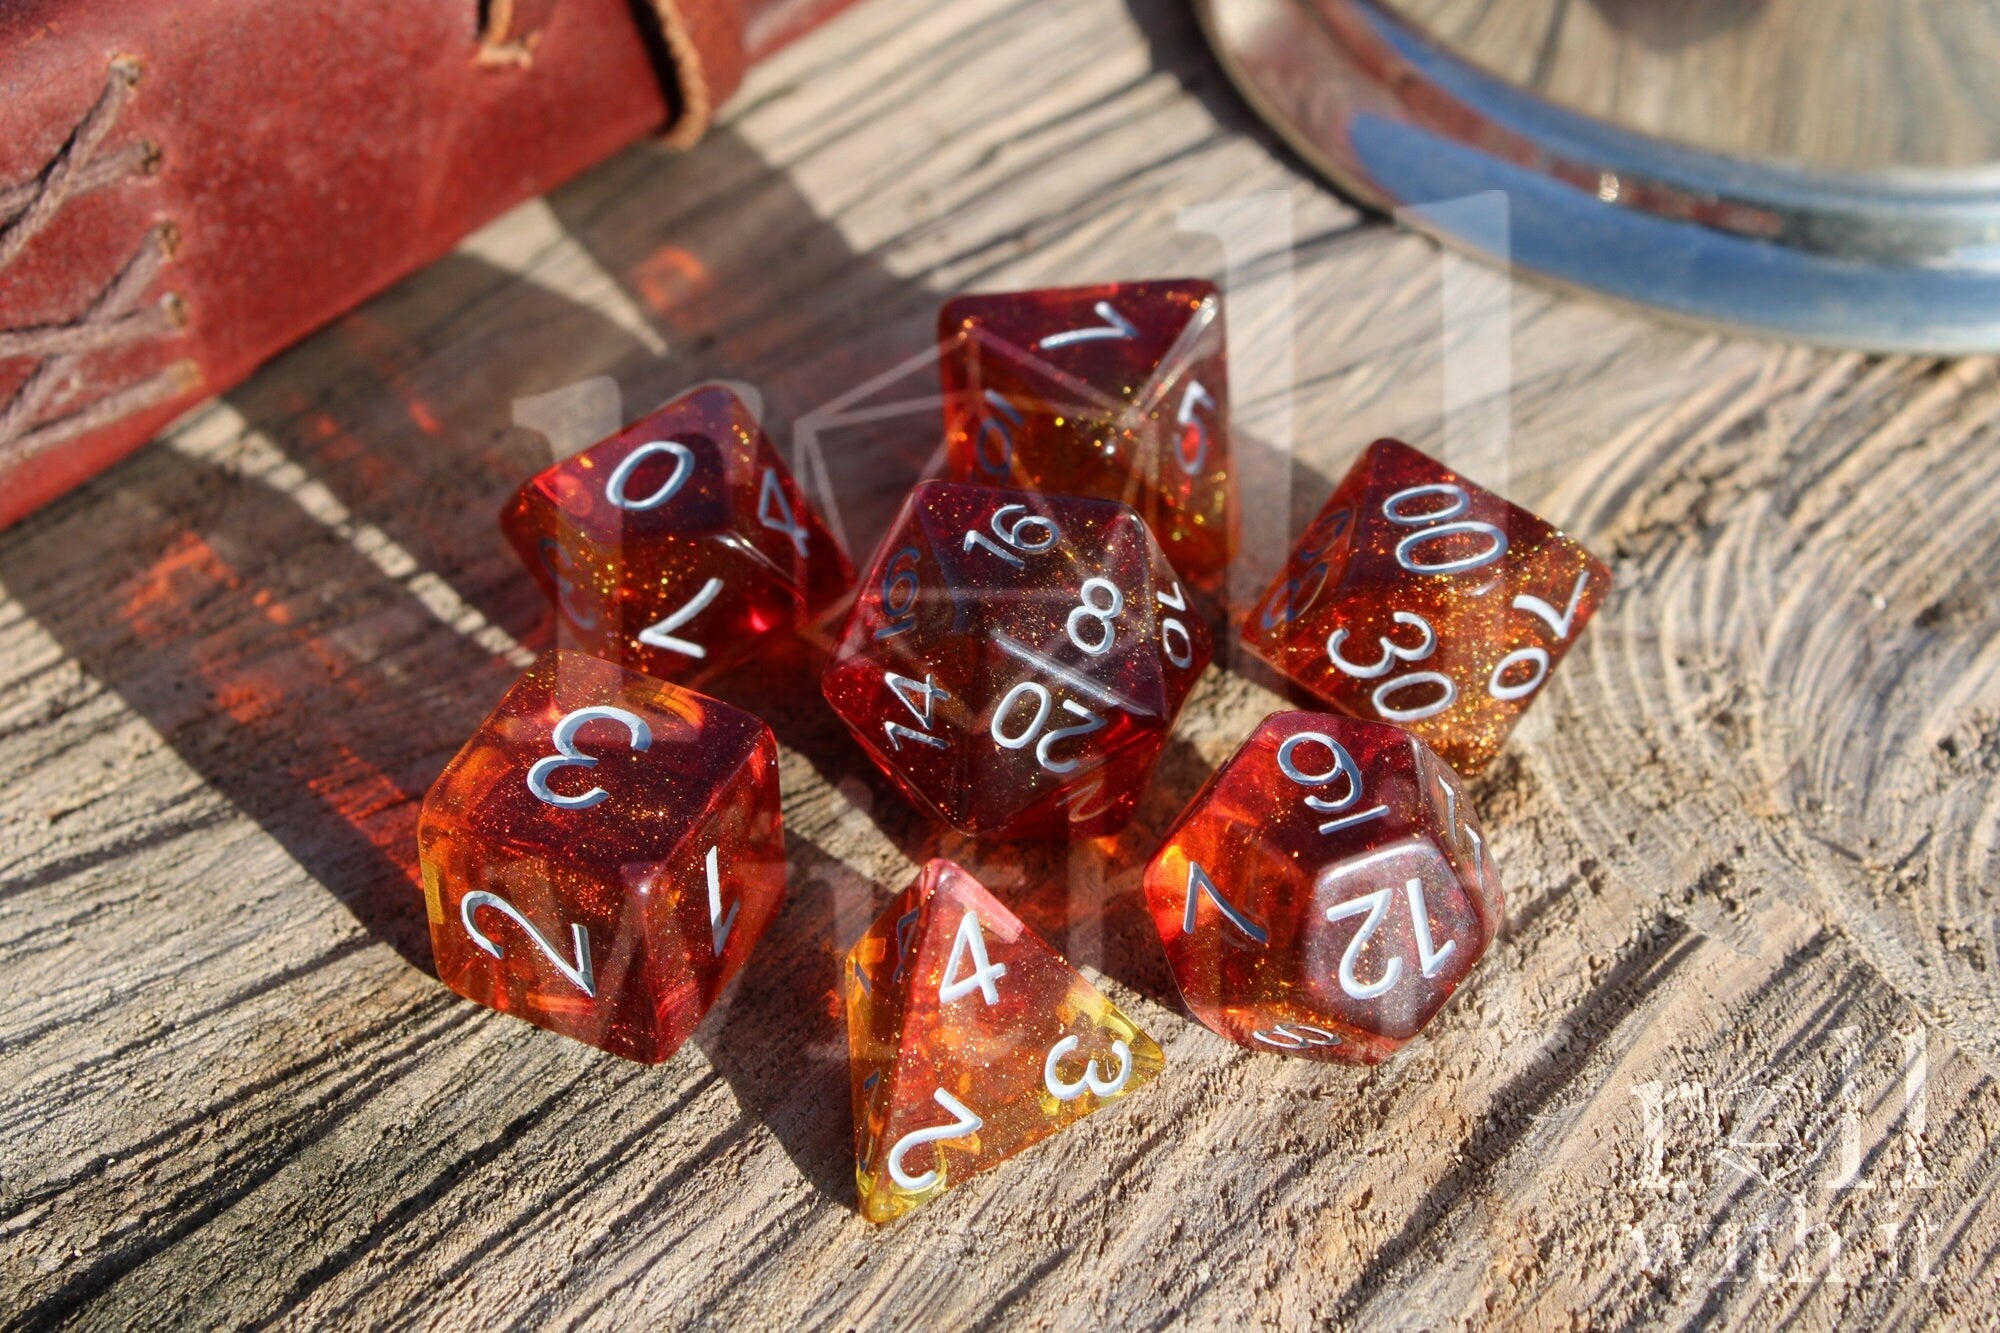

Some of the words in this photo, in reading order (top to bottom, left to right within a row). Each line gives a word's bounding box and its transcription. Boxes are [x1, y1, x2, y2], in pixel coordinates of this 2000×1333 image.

[1175, 379, 1217, 476] 5
[606, 440, 696, 512] 0
[758, 467, 811, 558] 4
[962, 503, 1061, 571] 16
[1382, 483, 1509, 576] 00
[1067, 577, 1123, 655] 8
[1157, 582, 1193, 669] 10
[1488, 570, 1591, 700] 70
[884, 671, 951, 752] 14
[1326, 610, 1459, 722] 30
[526, 705, 653, 810] 3
[991, 681, 1108, 774] 20
[1437, 773, 1485, 892] 11
[461, 889, 595, 998] 2
[706, 845, 741, 958] 1
[1182, 860, 1269, 944] 7
[1326, 877, 1458, 1000] 12
[940, 910, 1007, 1006] 4
[1044, 1034, 1133, 1101] 3
[1252, 1023, 1343, 1049] 8
[887, 1086, 984, 1191] 2
